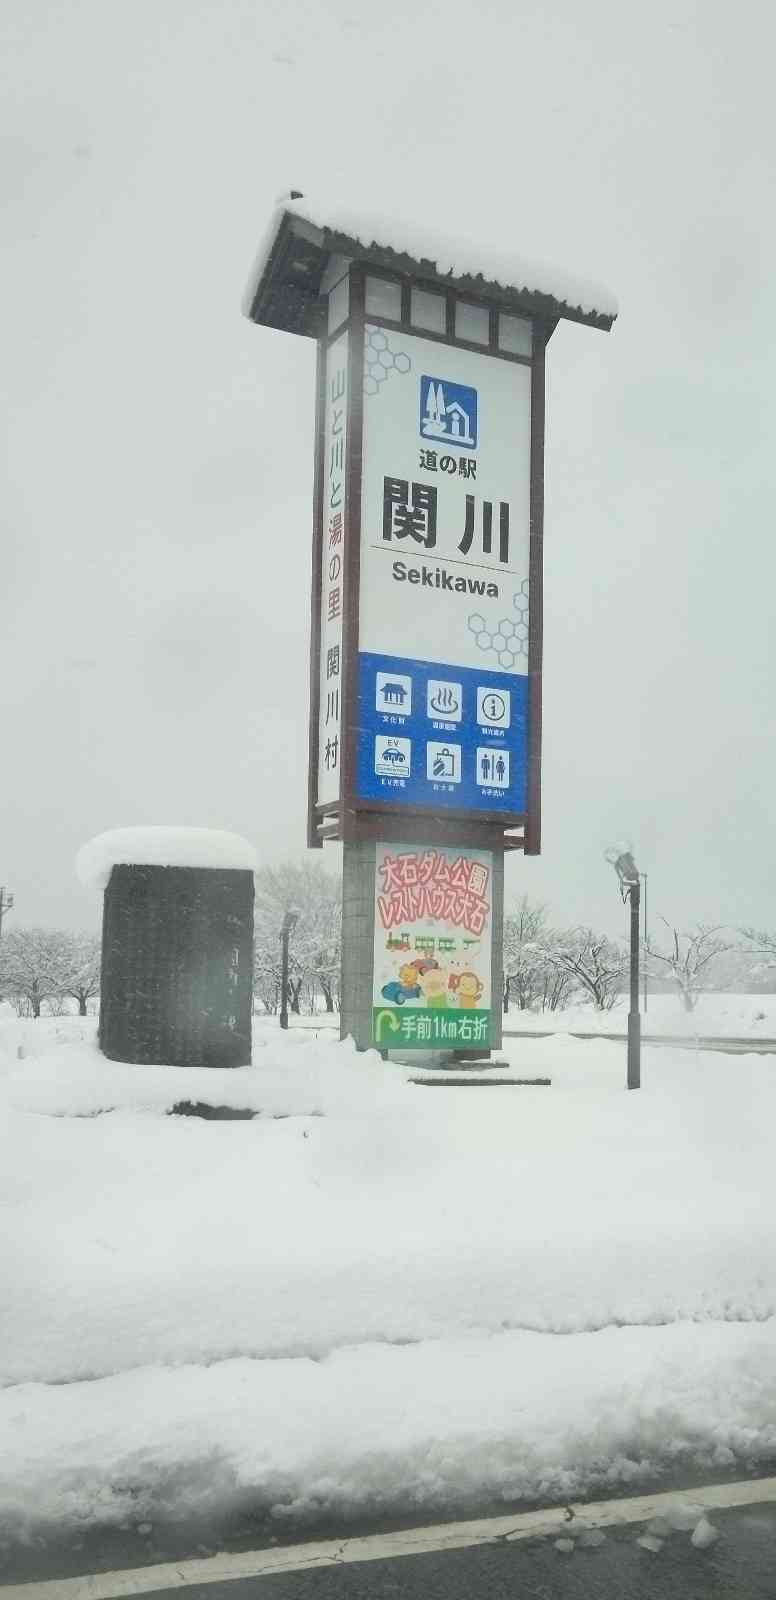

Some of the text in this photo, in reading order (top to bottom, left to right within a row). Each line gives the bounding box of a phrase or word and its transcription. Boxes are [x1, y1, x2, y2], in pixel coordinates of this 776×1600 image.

[418, 448, 478, 480] 道の駅
[382, 475, 510, 563] 関川
[324, 368, 346, 771] 山と川と湯の里 関川村
[391, 561, 500, 598] Sekikawa
[378, 850, 489, 898] 大石ダム公園
[377, 886, 491, 937] レストハウス大石
[401, 1015, 488, 1041] 手前1km右折
